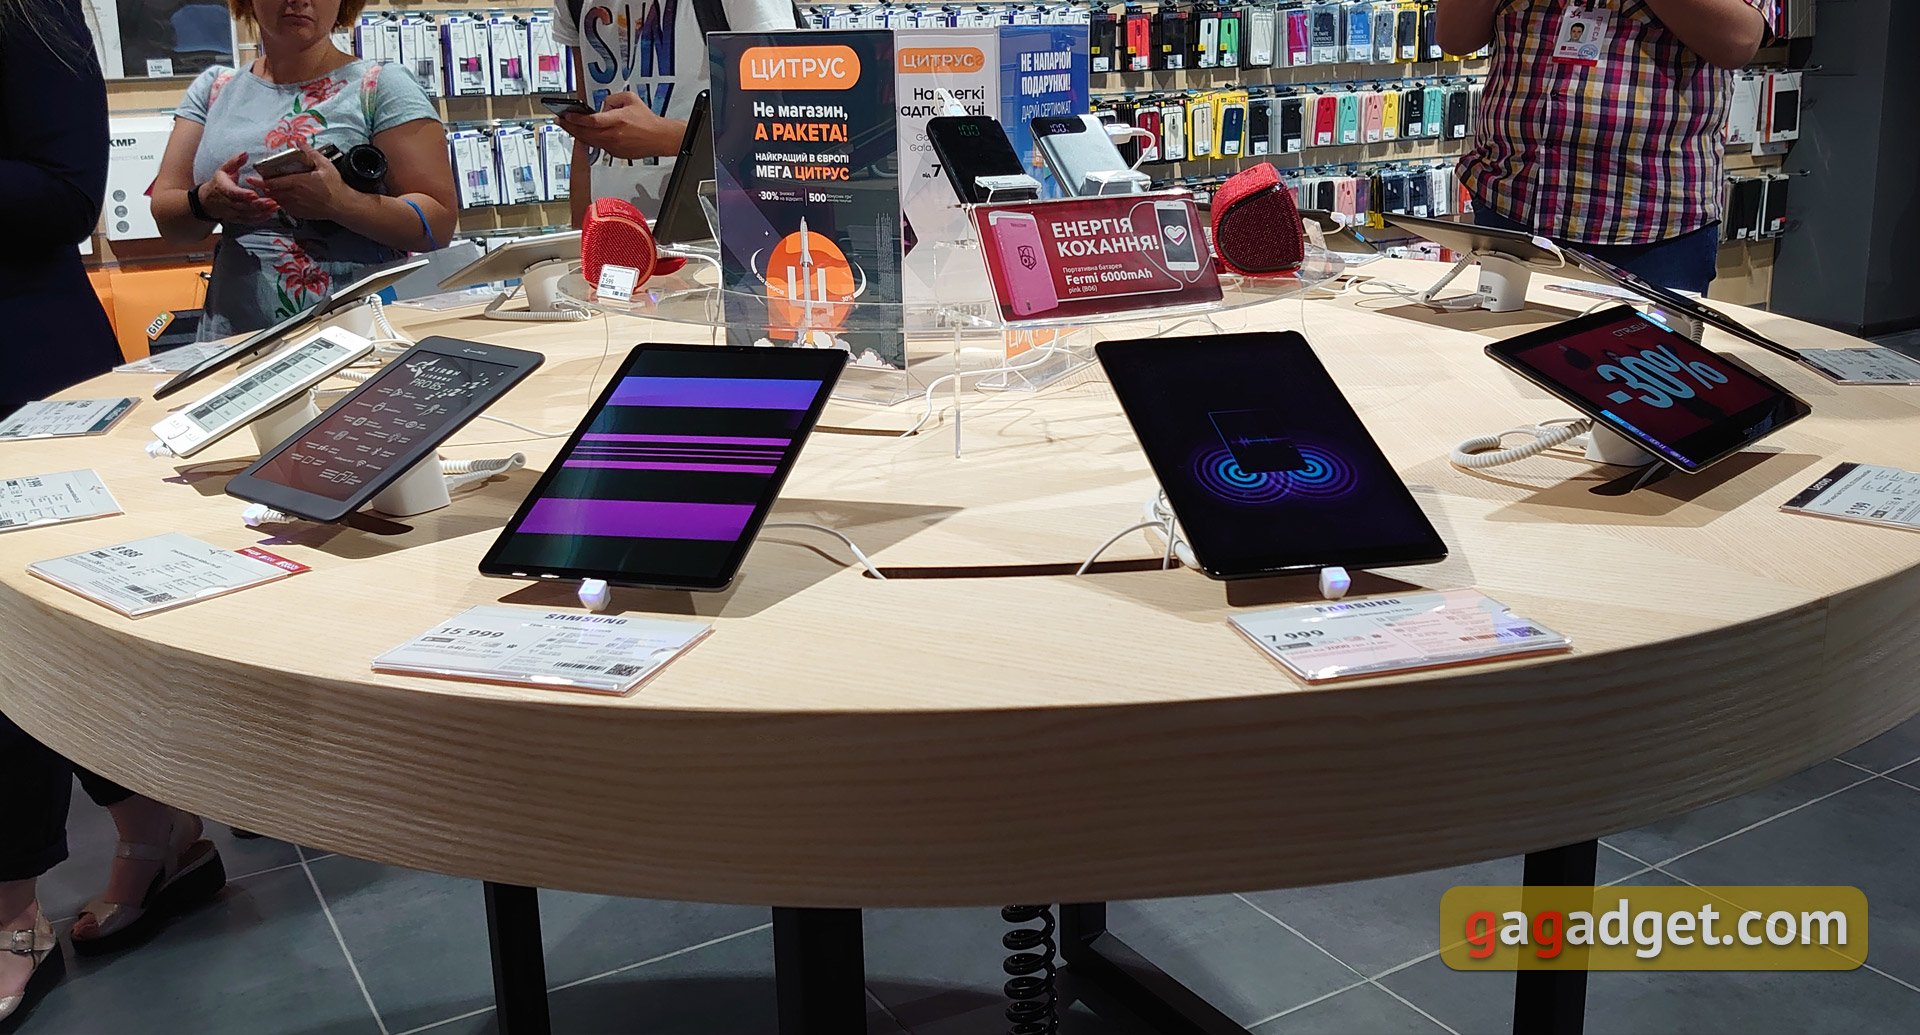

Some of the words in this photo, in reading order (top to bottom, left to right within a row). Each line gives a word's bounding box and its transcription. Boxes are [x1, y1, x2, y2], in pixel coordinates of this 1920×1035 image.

[584, 0, 677, 84] SUN
[902, 53, 975, 68] ЦИТРУС
[1020, 53, 1032, 72] НЕ
[1033, 47, 1072, 71] НАПАРЮЙ
[751, 57, 846, 80] ЦИТРУС
[1021, 73, 1071, 97] ПОДАРУНКИ!
[753, 101, 774, 118] Не
[778, 104, 848, 120] магазин,
[1021, 103, 1040, 122] ДАРУЙ
[755, 123, 769, 141] А
[772, 123, 848, 143] РАКЕТА!
[958, 125, 980, 136] 100
[755, 152, 807, 163] НАЙКРАЩИЙ
[809, 154, 814, 162] В
[817, 154, 849, 163] ЄВРОПІ
[756, 165, 792, 178] МЕГА
[795, 166, 850, 181] ЦИТРУС
[758, 190, 779, 201] -30%
[809, 192, 826, 202] 500
[1051, 216, 1134, 239] ЕНЕРГІЯ
[1056, 234, 1160, 258] КОХАННЯ!
[1063, 265, 1098, 274] Портативна
[1099, 263, 1122, 272] батарея
[1065, 273, 1099, 285] Fermi
[1100, 267, 1153, 283] 6000mAh
[1068, 286, 1081, 294] pink
[1081, 284, 1098, 293] (B06)
[409, 378, 432, 388] PRO
[1596, 344, 1729, 408] -30%
[1314, 598, 1401, 613] SAMSUNG
[544, 613, 628, 625] SAMSUNG
[440, 627, 465, 636] 15
[466, 630, 504, 639] 999
[1264, 634, 1277, 642] 7
[1284, 629, 1325, 640] 999
